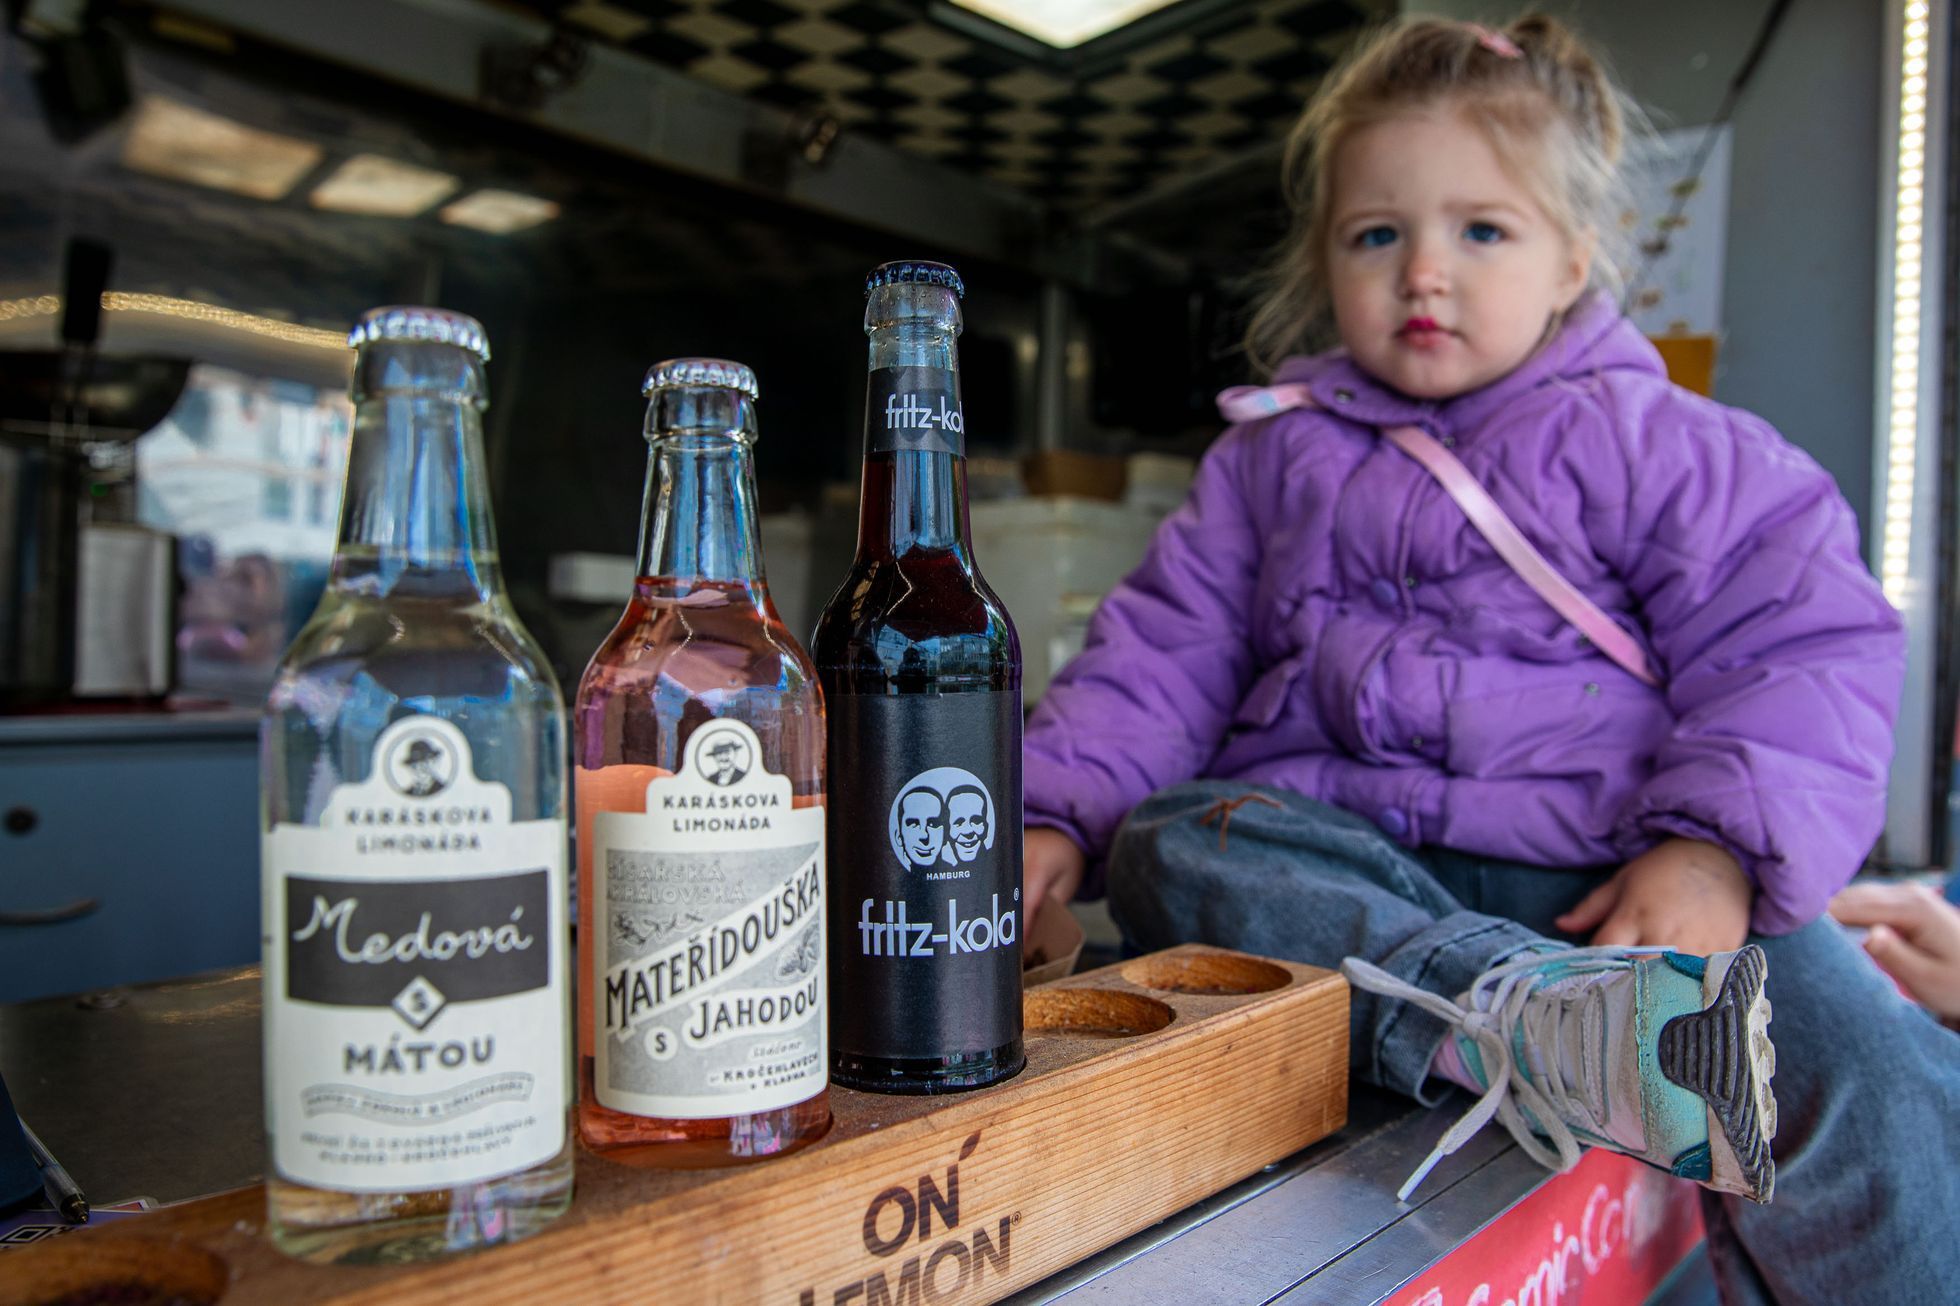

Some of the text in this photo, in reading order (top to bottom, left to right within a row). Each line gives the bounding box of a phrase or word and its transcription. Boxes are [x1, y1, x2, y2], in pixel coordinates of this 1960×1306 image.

[662, 791, 780, 810] KARÁSKOVA
[673, 813, 771, 833] LIMONÁDA
[926, 870, 971, 881] HAMBURG
[293, 894, 534, 964] Medová
[605, 860, 821, 1030] MATEŘÍDOUŠKA
[690, 976, 818, 1040] JAHODOU
[343, 1032, 496, 1074] MÁTOU
